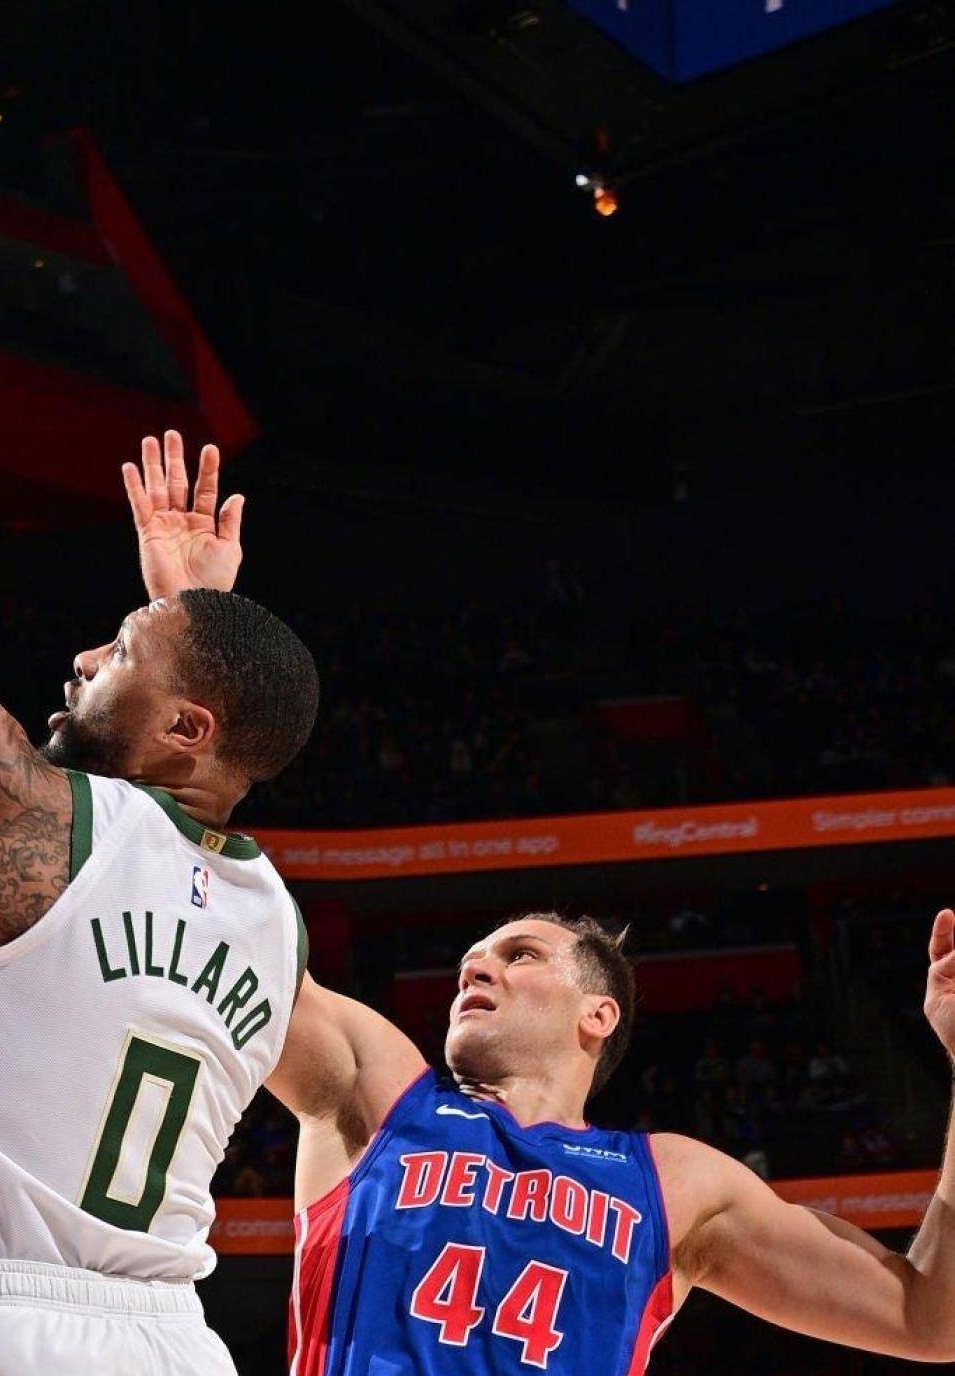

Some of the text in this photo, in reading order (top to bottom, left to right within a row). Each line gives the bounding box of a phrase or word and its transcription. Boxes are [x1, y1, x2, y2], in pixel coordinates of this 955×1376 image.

[91, 910, 273, 1051] LILLARD
[78, 1028, 205, 1234] 0
[395, 1151, 642, 1264] DETROIT
[410, 1242, 569, 1369] 44
